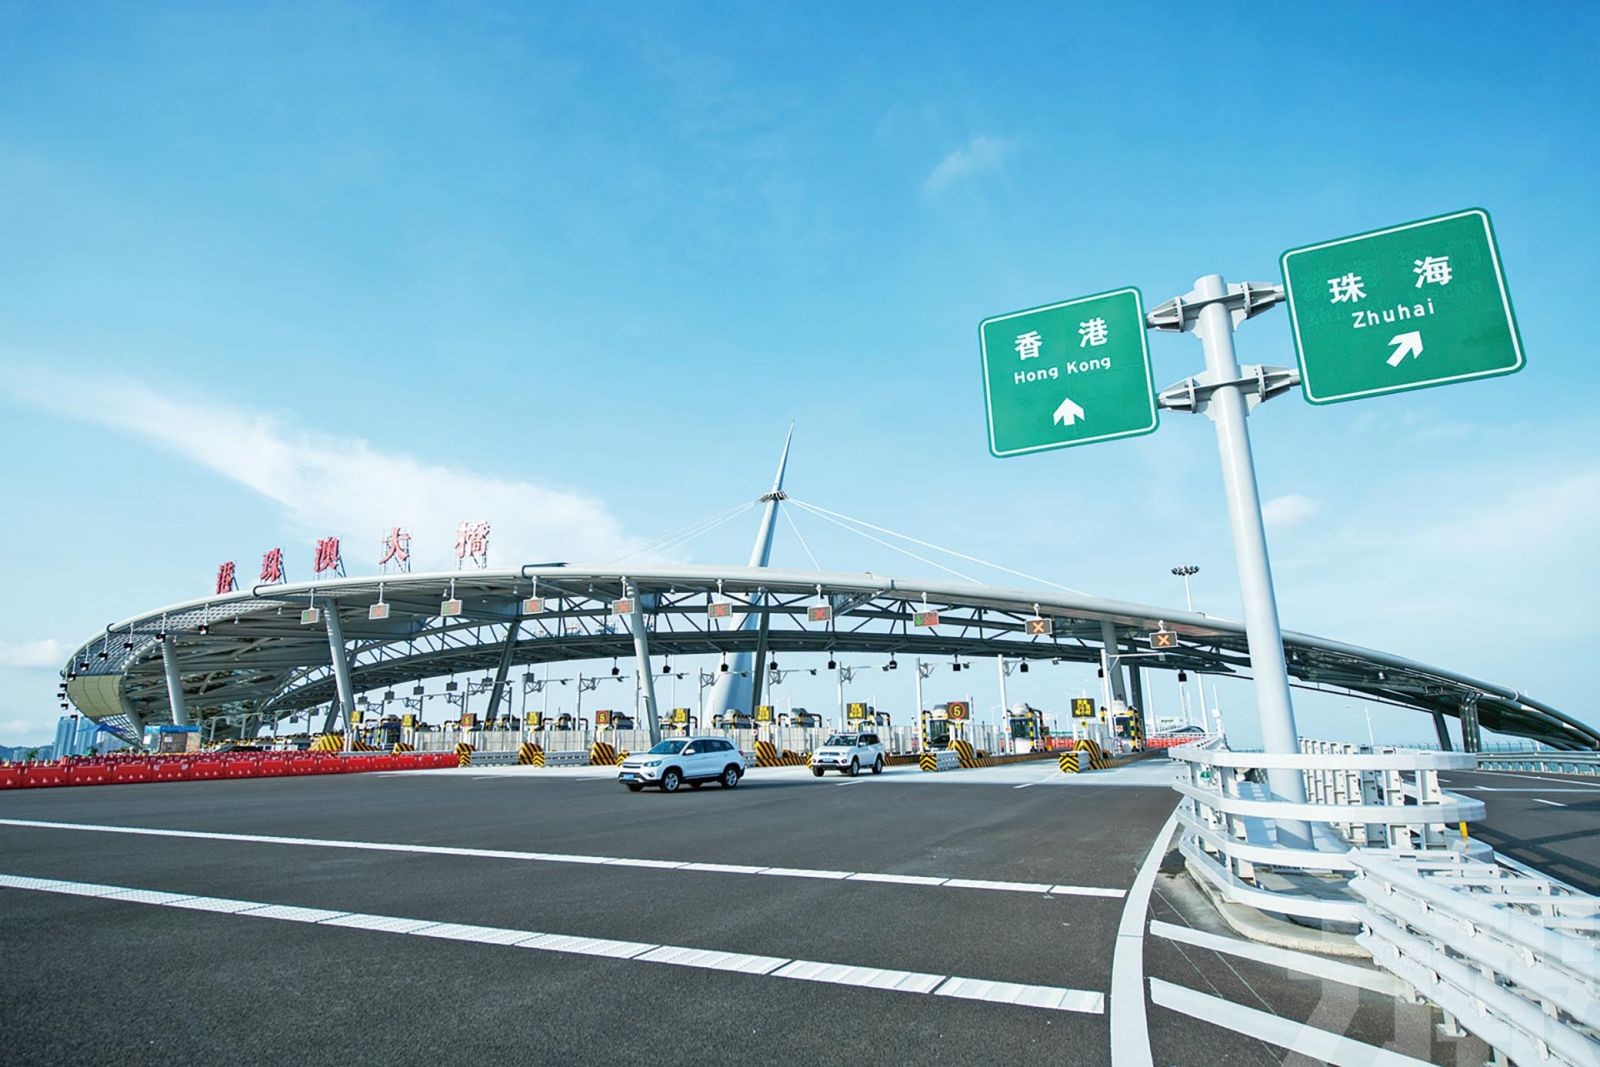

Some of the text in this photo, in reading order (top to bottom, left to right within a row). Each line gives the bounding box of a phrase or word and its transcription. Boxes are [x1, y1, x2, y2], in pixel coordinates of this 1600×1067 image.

[1329, 254, 1453, 305] 珠海
[1352, 298, 1436, 330] Zhuhai
[1014, 316, 1110, 361] 香港
[1013, 355, 1112, 386] Hong Kong
